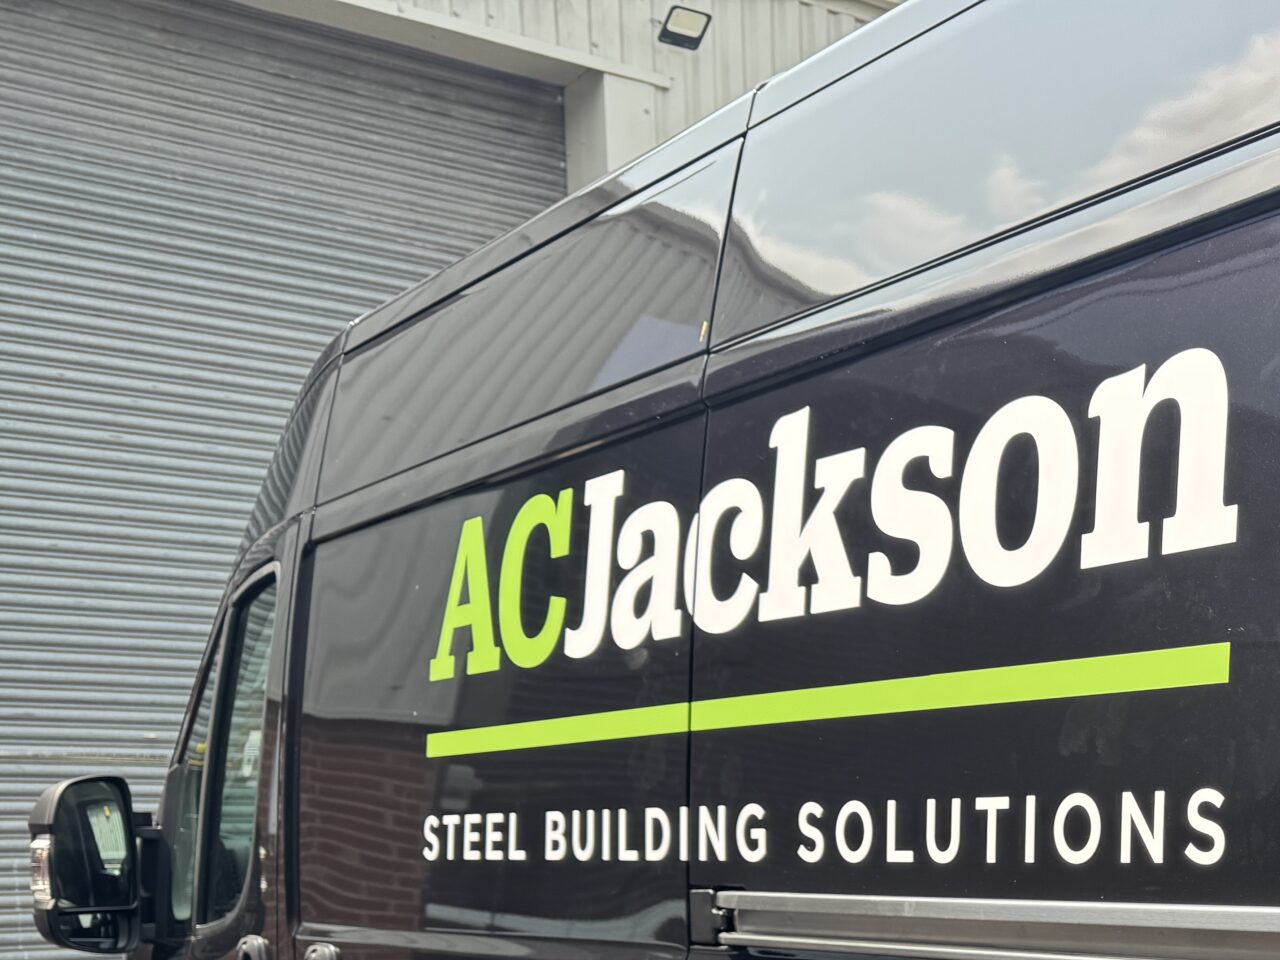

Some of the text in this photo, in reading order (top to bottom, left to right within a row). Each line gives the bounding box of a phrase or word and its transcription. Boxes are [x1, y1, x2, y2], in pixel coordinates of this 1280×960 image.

[428, 346, 1239, 683] ACJackson
[422, 786, 1227, 866] STEEL BUILDING SOLUTIONS
